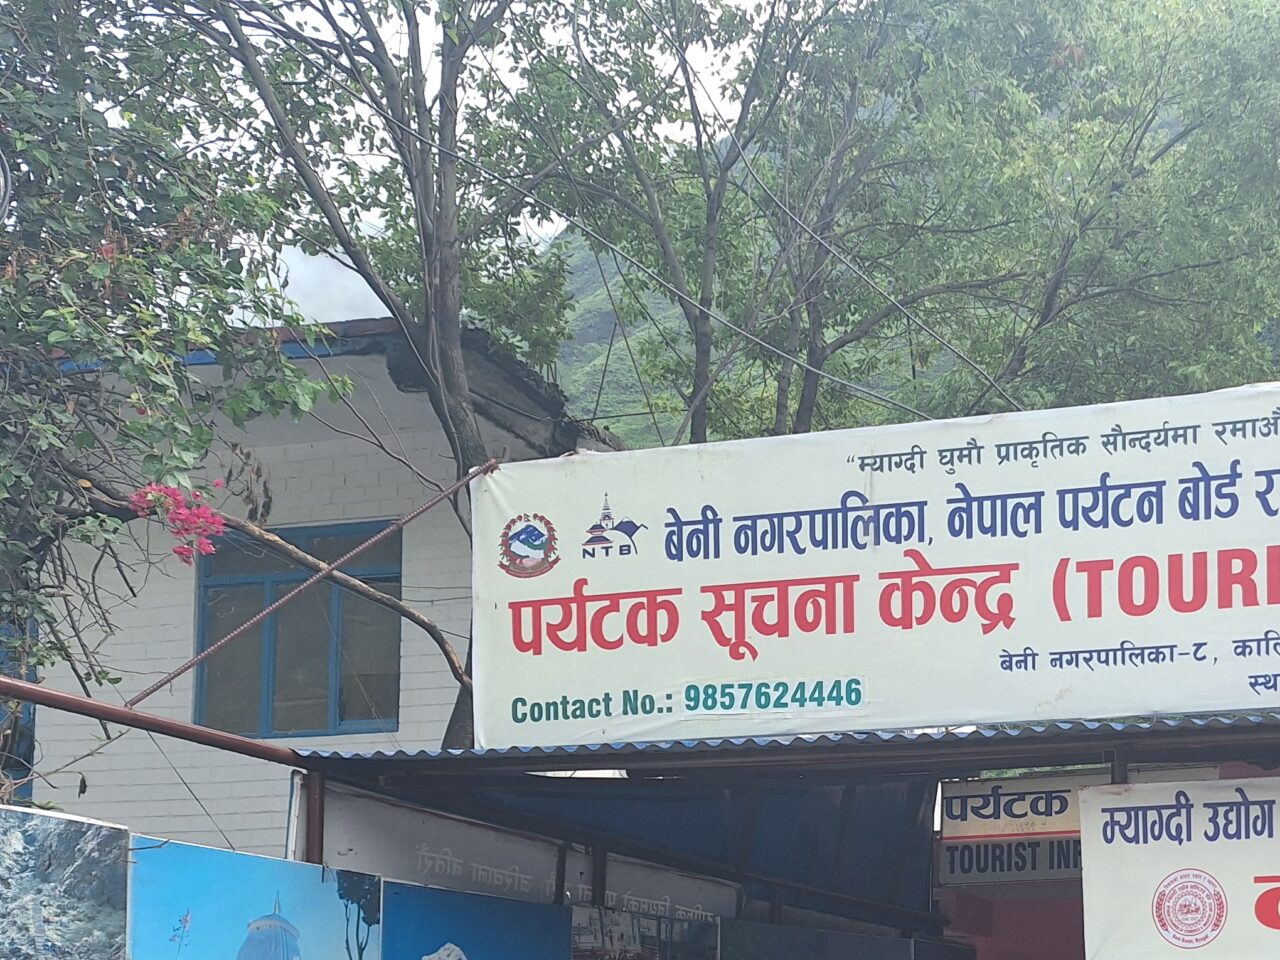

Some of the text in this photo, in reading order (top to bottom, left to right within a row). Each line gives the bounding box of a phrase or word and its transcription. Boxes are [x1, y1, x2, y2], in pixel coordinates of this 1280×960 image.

[937, 438, 984, 474] घुमौ
[995, 432, 1089, 468] प्राकृतिक
[1100, 421, 1201, 455] सौन्दर्यमा
[665, 505, 722, 561] बेनी
[733, 491, 932, 561] नगरपालिका,
[947, 483, 1045, 539] नेपाल
[1056, 472, 1166, 531] पर्यटन
[1178, 459, 1242, 521] बोर्ड
[1255, 469, 1280, 517] र
[582, 544, 632, 559] NTB
[508, 578, 682, 655] पर्यटक
[700, 575, 860, 661] सूचना
[879, 549, 1019, 635] केन्द्र
[999, 647, 1039, 671] बेनी
[512, 693, 612, 723] Contact
[685, 679, 861, 711] 9857624446
[944, 785, 1071, 822] पर्यटक
[1101, 790, 1194, 846] म्याग्दी
[1203, 784, 1276, 841] उद्योग
[946, 841, 1040, 875] TOURIST
